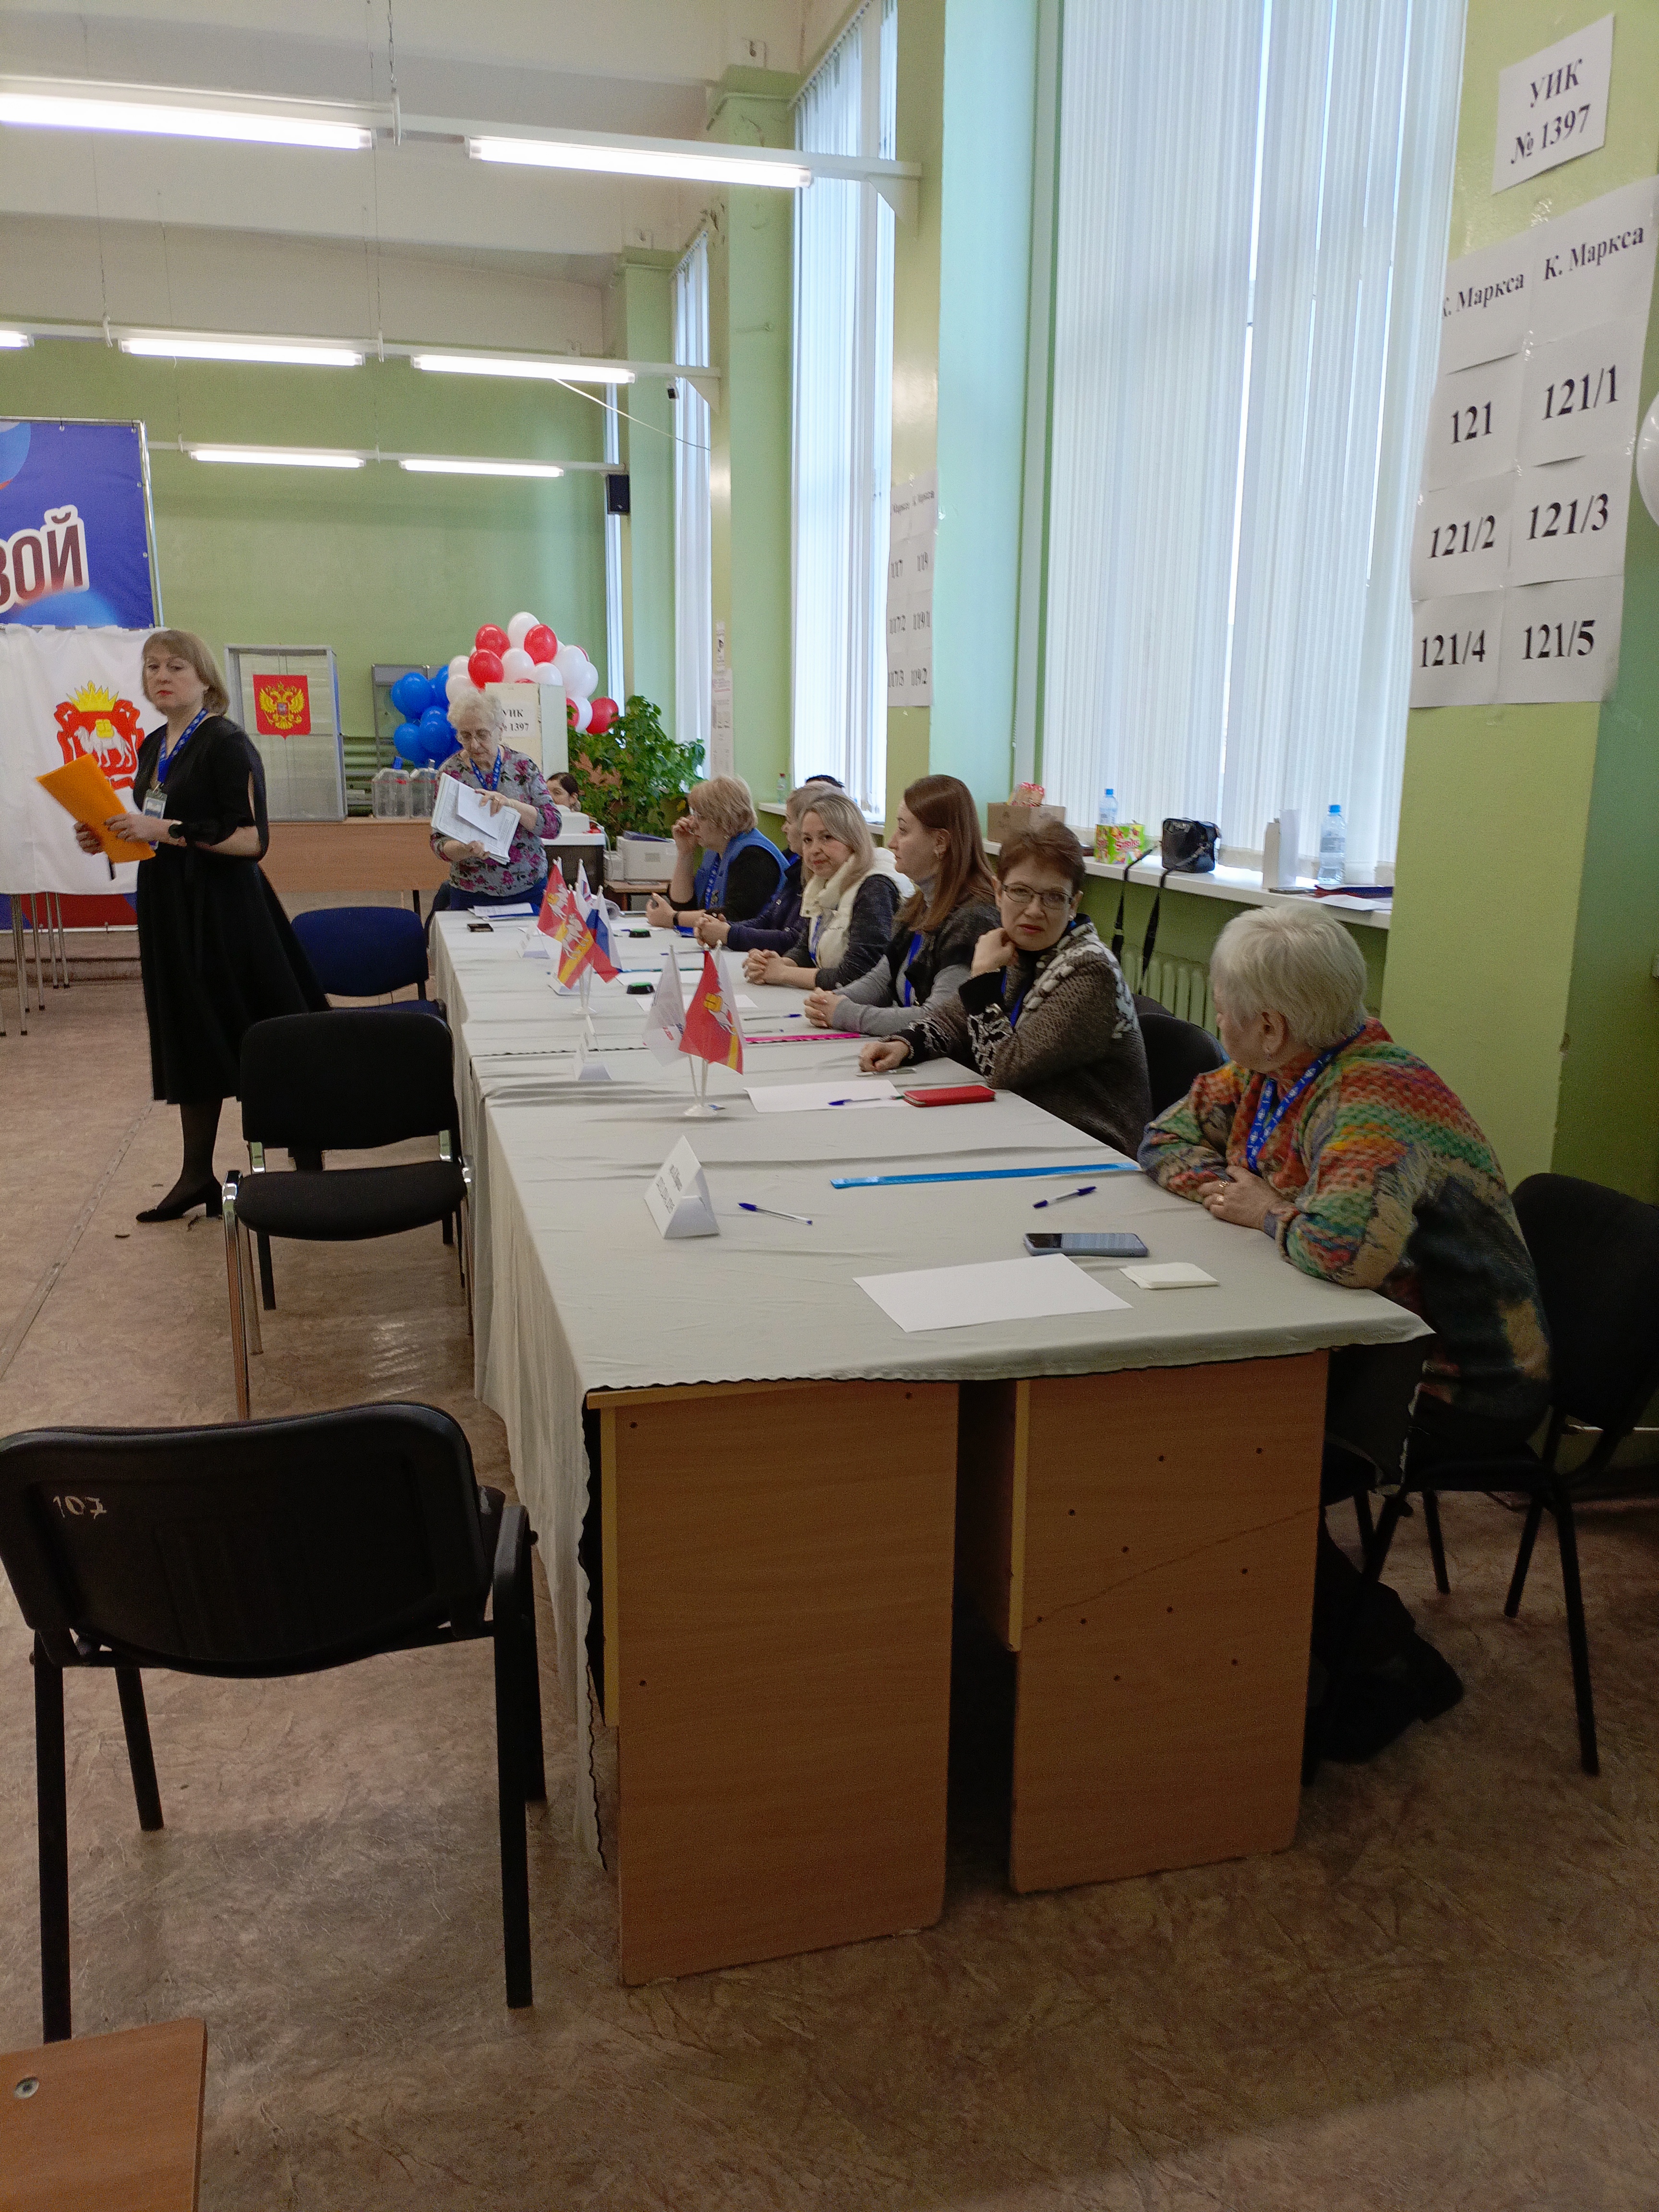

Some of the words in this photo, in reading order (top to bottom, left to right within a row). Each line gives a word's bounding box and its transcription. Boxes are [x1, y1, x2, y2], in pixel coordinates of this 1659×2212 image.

[1530, 58, 1583, 108] УИК
[1511, 132, 1534, 164] №
[1541, 103, 1591, 151] 1397
[1544, 254, 1563, 281] К.
[1568, 226, 1645, 272] Маркса
[1455, 274, 1524, 313] Маркса
[1541, 364, 1620, 421] 121/1
[1451, 400, 1493, 445] 121
[1428, 515, 1496, 559] 121/2
[1526, 493, 1609, 541] 121/3
[1419, 629, 1486, 668] 121/4
[1522, 619, 1596, 661] 121/5
[510, 722, 529, 732] 1397
[53, 1495, 108, 1520] 107
